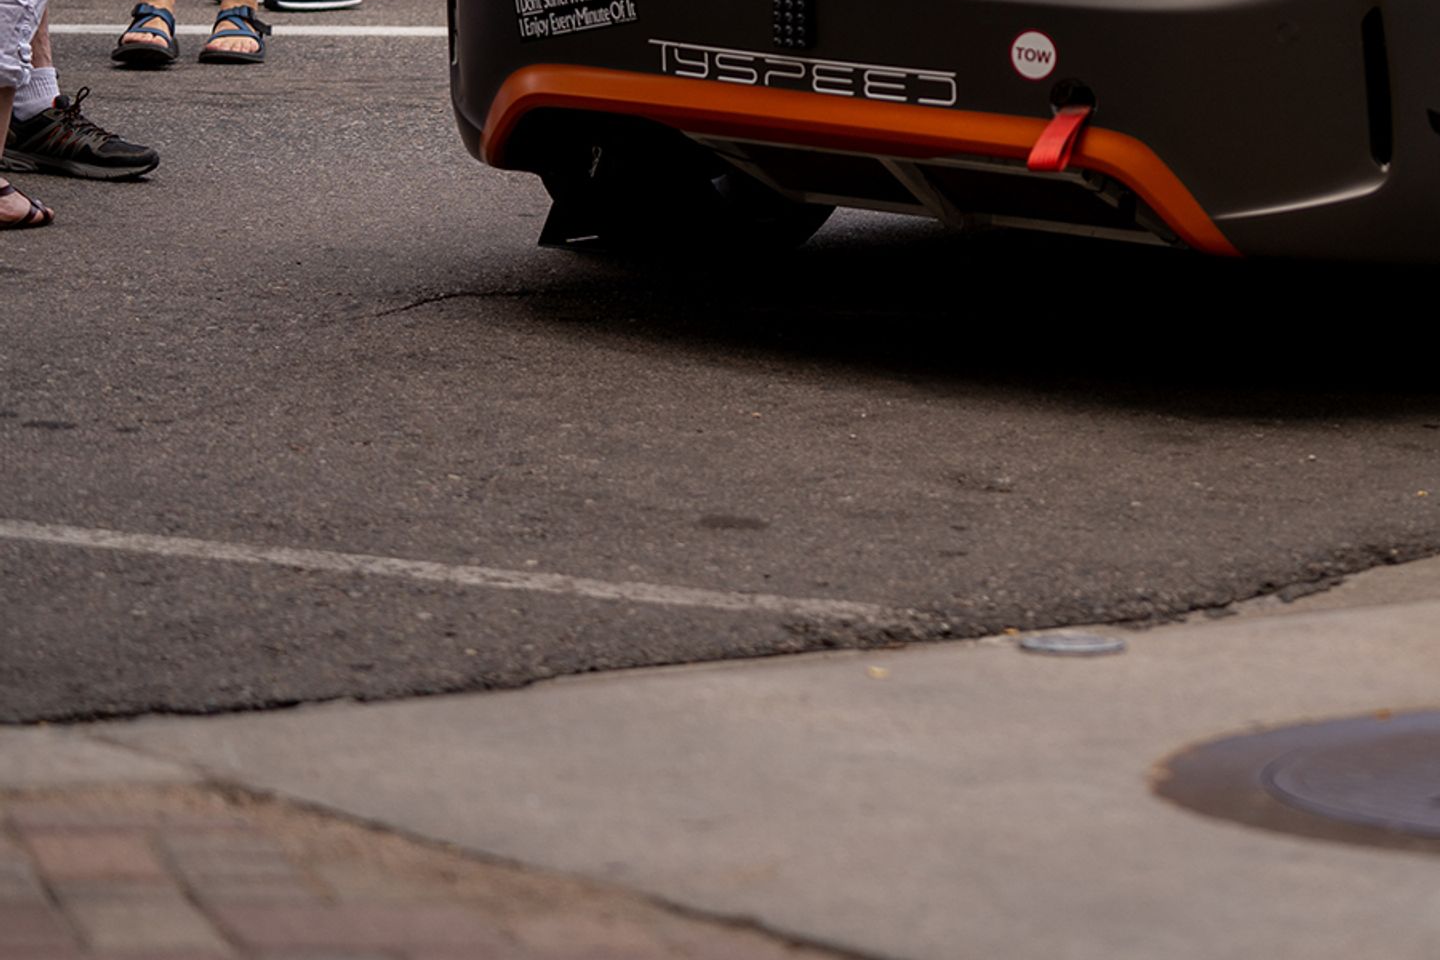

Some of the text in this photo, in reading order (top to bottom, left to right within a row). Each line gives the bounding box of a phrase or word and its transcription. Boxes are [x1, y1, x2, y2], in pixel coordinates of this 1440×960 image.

[524, 16, 549, 38] Enjoy
[549, 12, 576, 34] Every
[575, 7, 611, 28] Minute
[610, 0, 625, 21] Of
[1016, 47, 1052, 65] TOW
